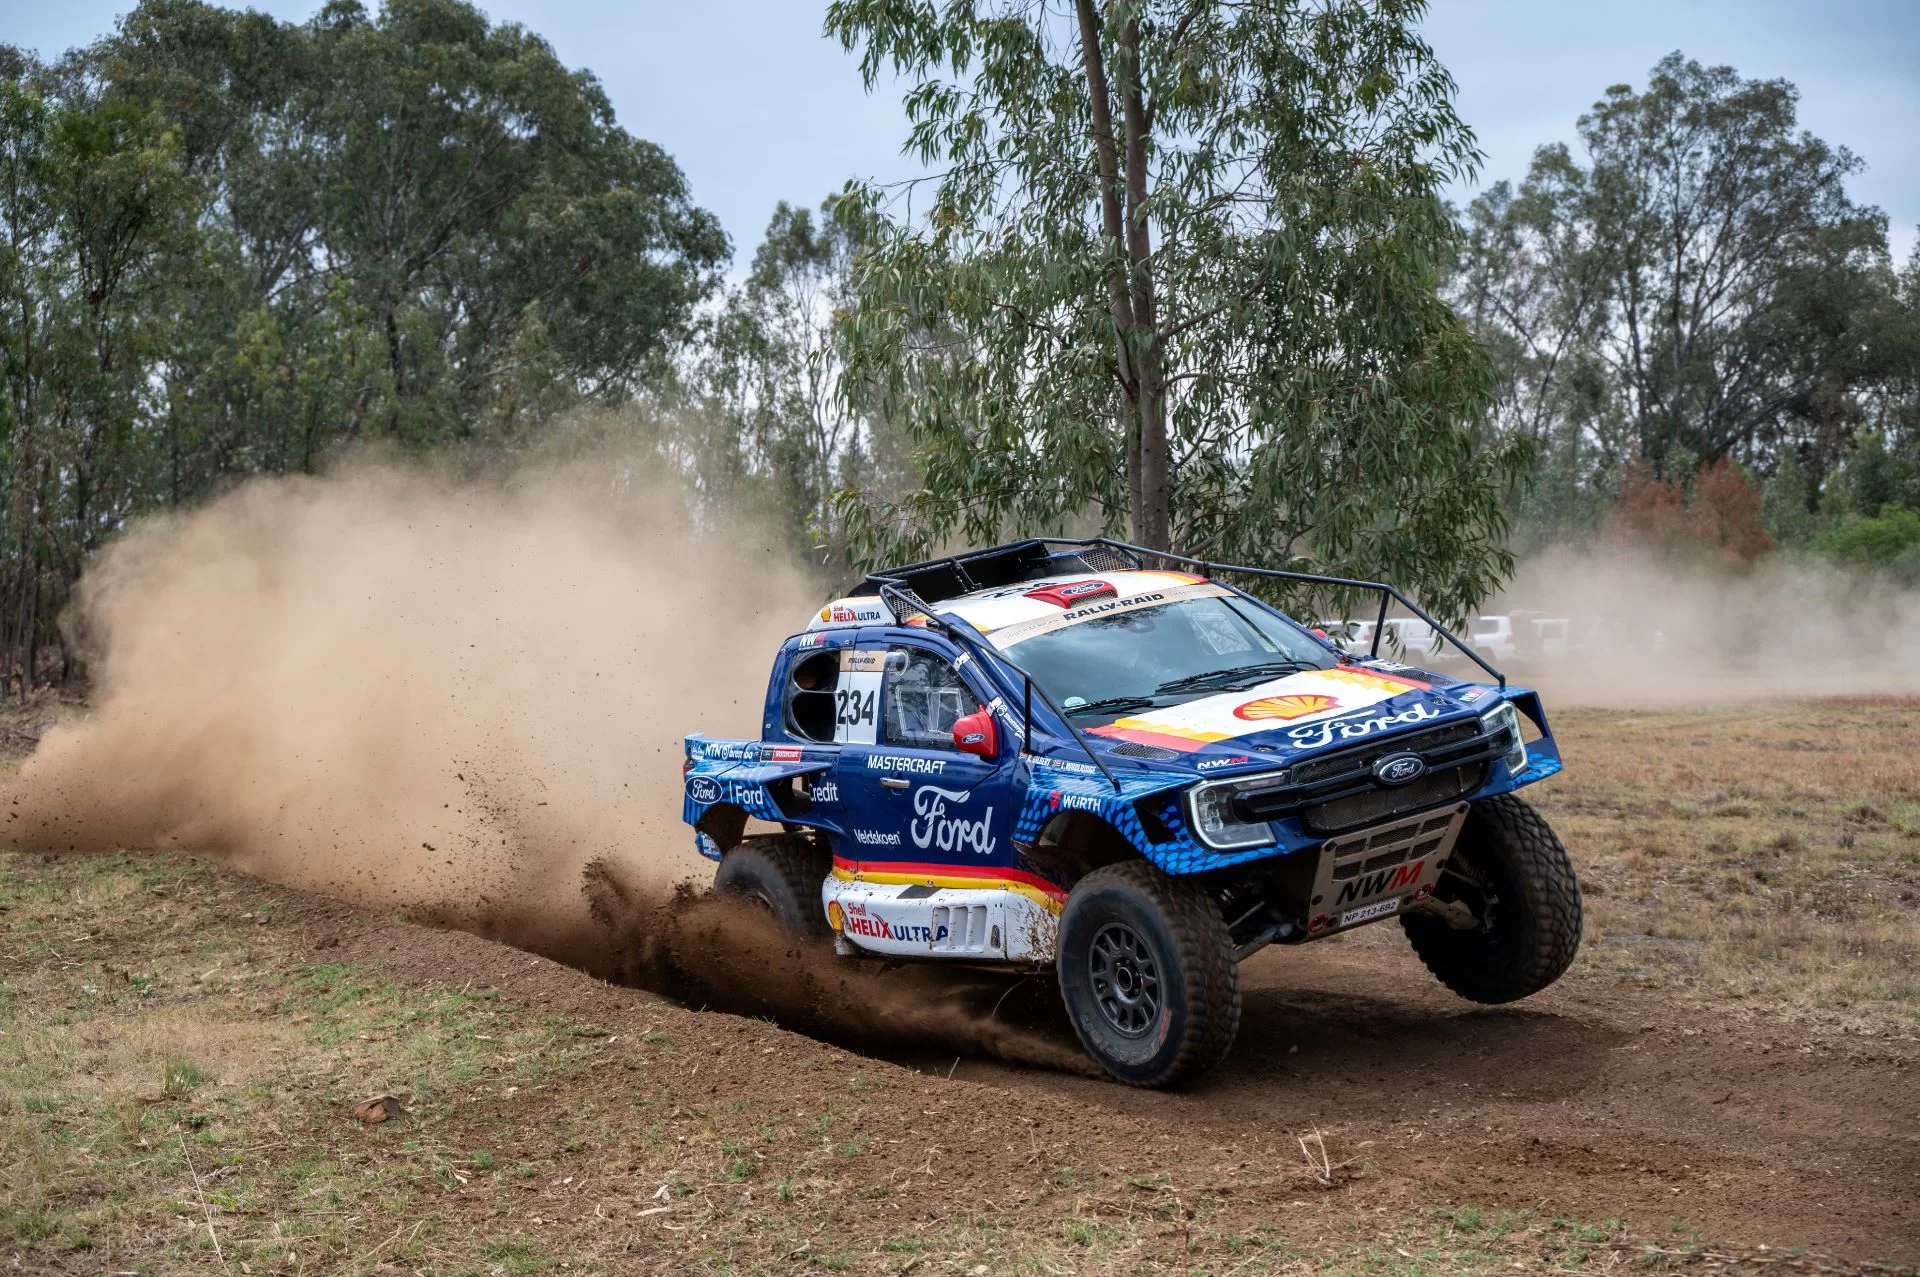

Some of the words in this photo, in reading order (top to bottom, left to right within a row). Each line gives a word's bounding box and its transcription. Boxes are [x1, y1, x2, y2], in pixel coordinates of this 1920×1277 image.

[1071, 584, 1097, 594] Ford
[833, 610, 857, 622] HELIX
[857, 611, 881, 621] ULTRA
[1062, 593, 1165, 621] RALLY-RAID
[836, 689, 875, 726] 234
[1288, 702, 1440, 749] Ford
[867, 755, 946, 775] MASTERCRAFT
[1197, 755, 1249, 769] NWM
[1391, 761, 1416, 779] Ford
[692, 778, 717, 800] Ford
[735, 785, 764, 805] Ford
[1063, 794, 1102, 812] WÜRTH
[911, 785, 996, 855] Ford
[854, 828, 901, 846] Veldskoen
[1335, 860, 1425, 906] NWM
[848, 902, 866, 917] Shell
[1343, 912, 1358, 923] NP
[1359, 901, 1397, 918] 213-692
[850, 914, 895, 940] HELIX
[894, 924, 949, 943] ULTRA
